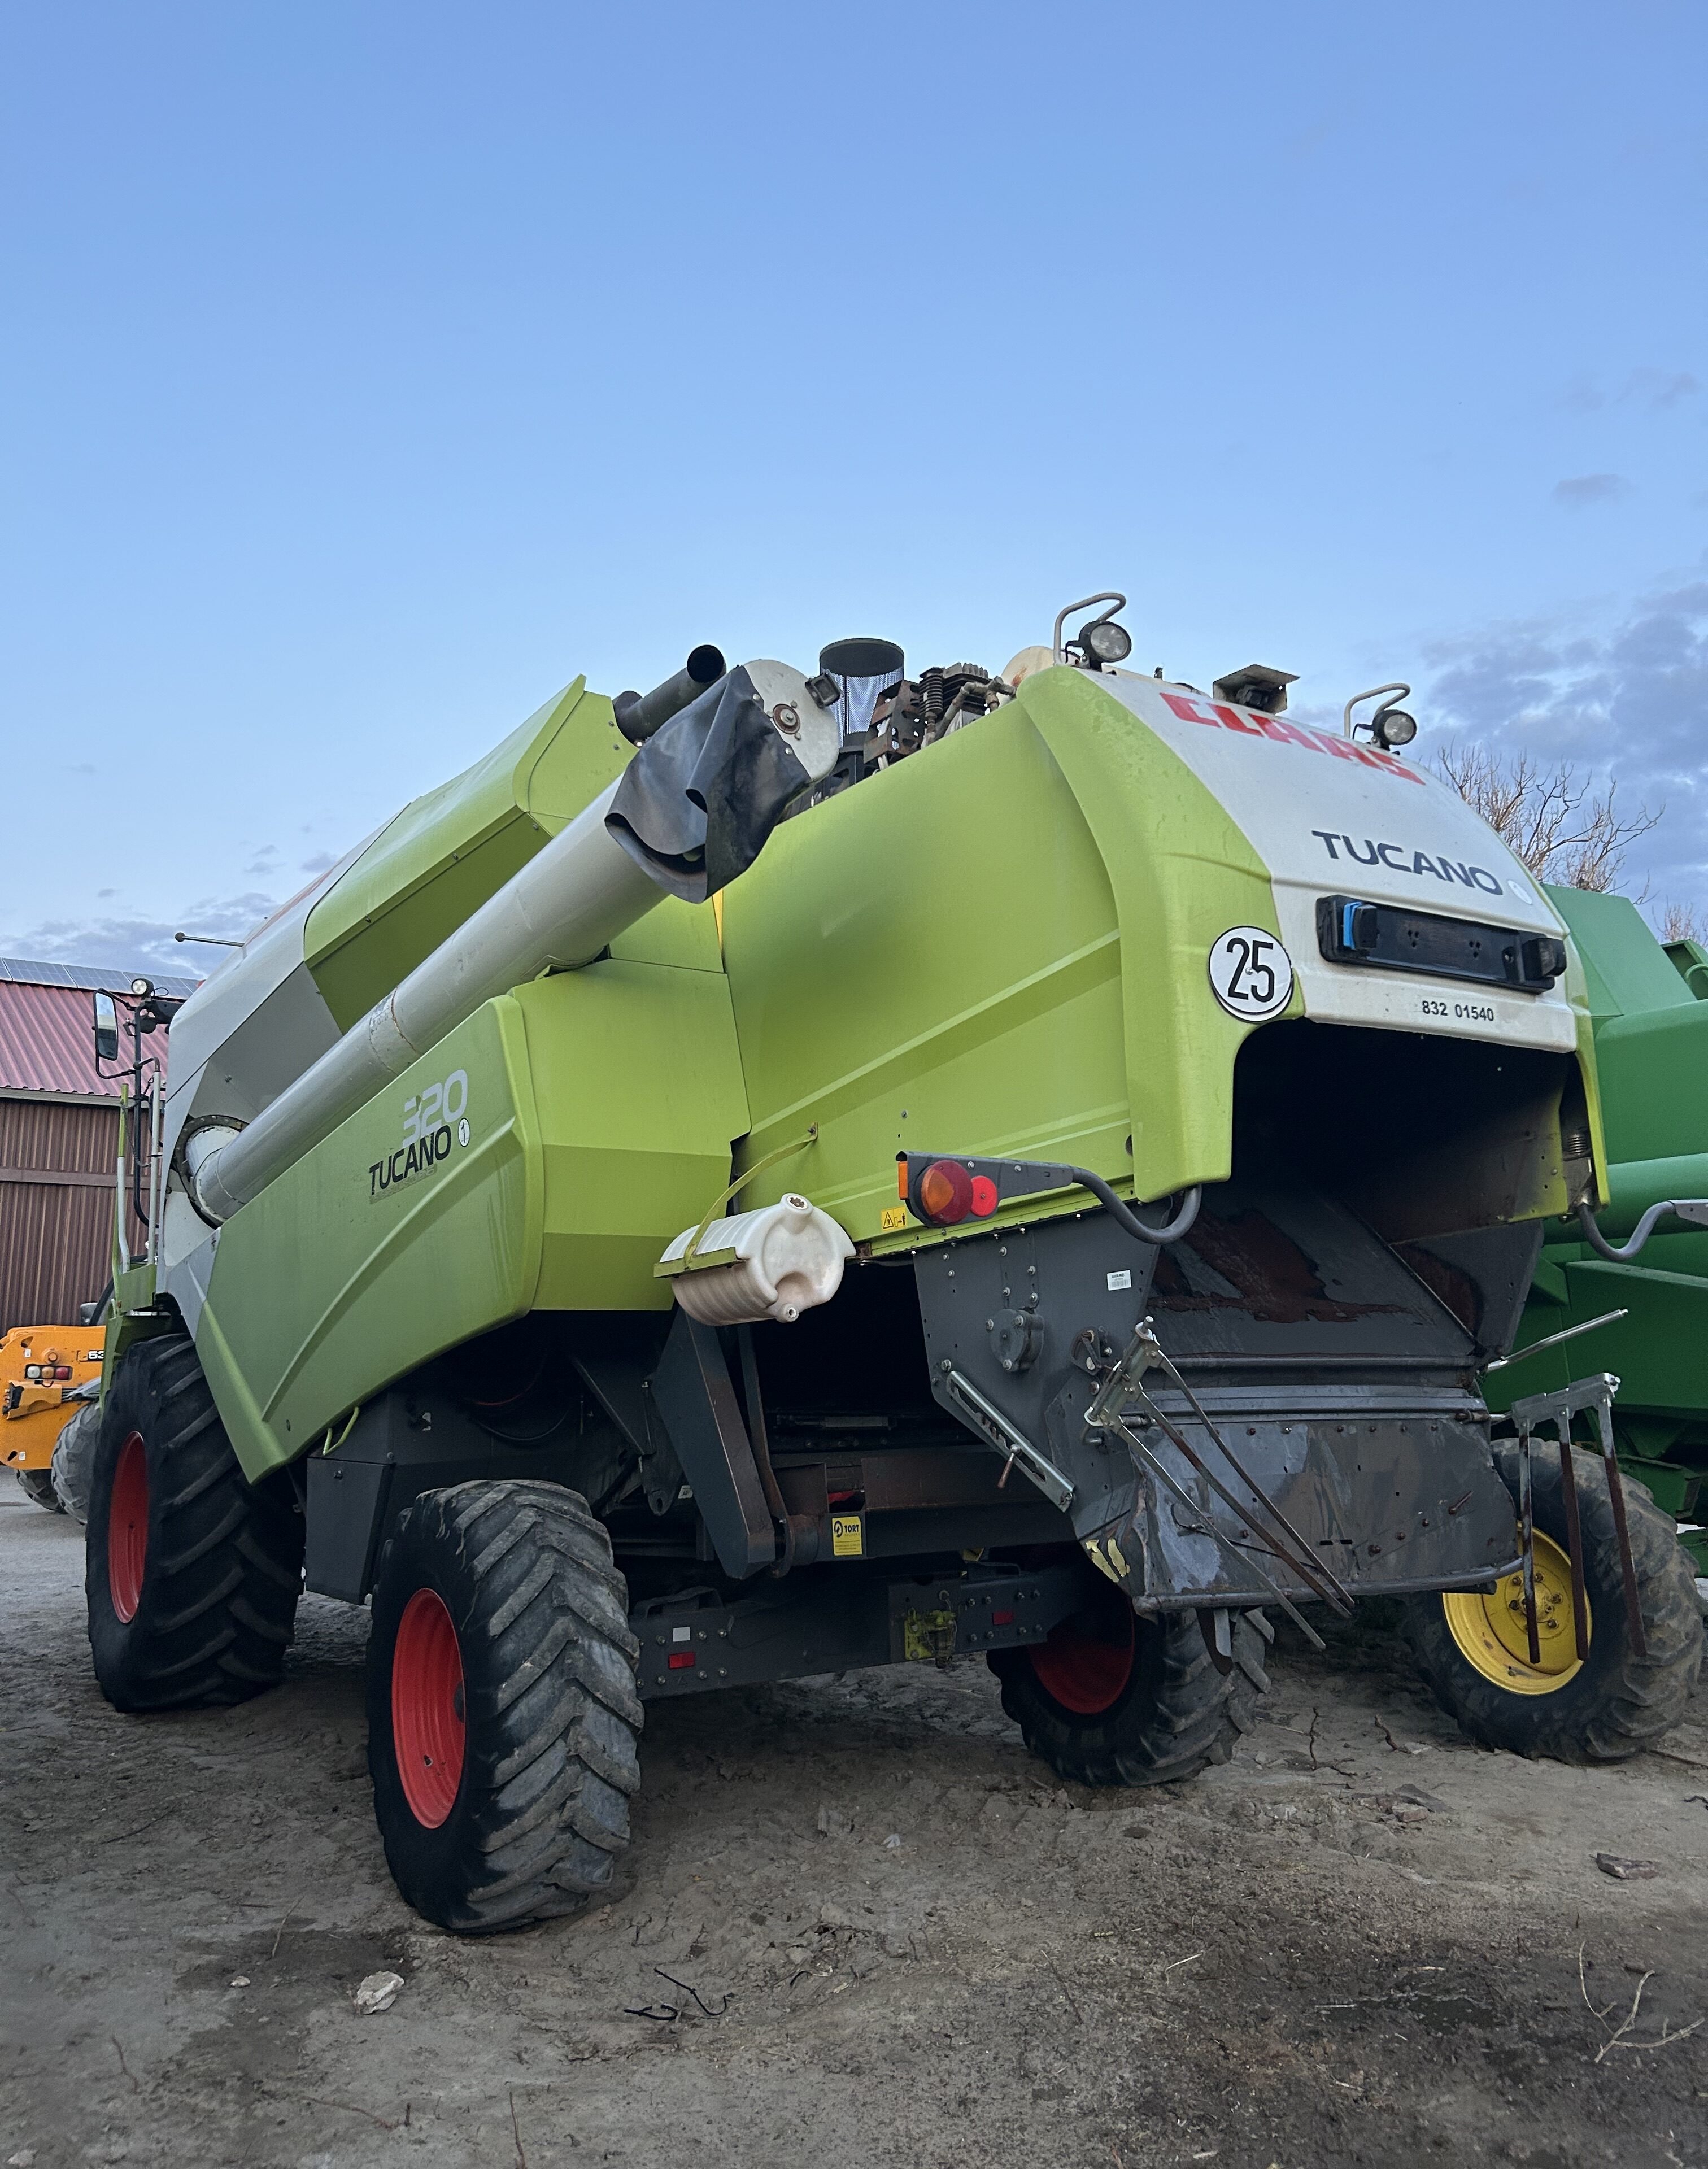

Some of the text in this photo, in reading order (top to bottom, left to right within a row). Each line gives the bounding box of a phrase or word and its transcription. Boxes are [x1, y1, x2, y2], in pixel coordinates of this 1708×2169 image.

[1311, 830, 1504, 896] TUCANO
[1226, 937, 1275, 1003] 25
[1422, 1000, 1494, 1021] 832 01540
[402, 1069, 468, 1149] 320
[369, 1125, 451, 1195] TUCANO
[844, 1524, 859, 1533] TORT
